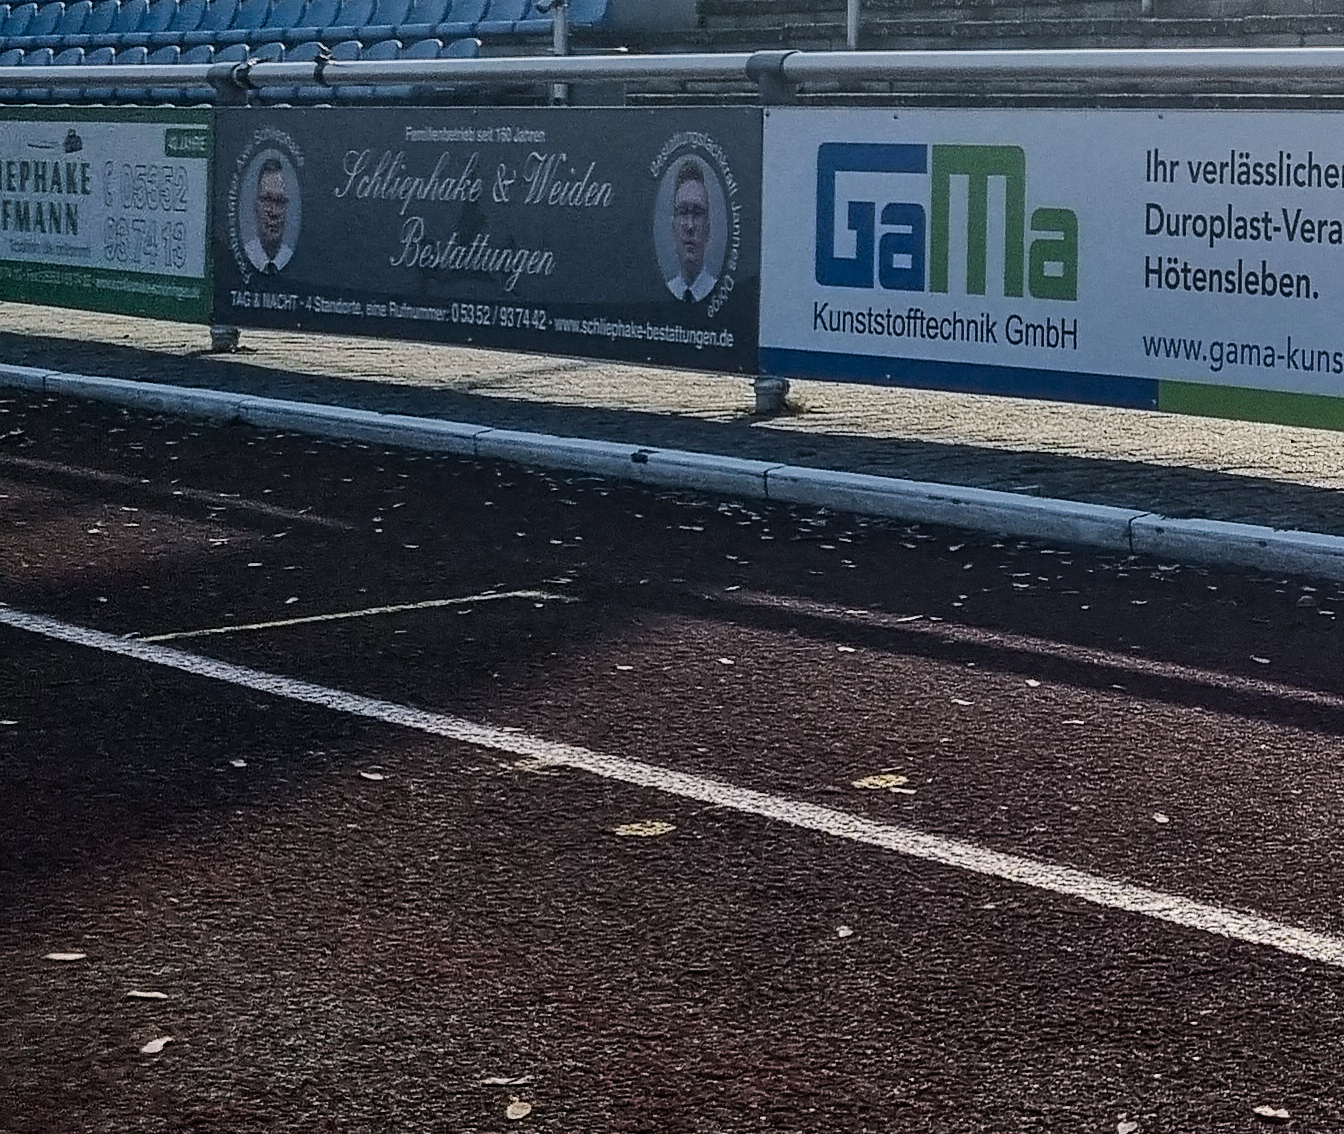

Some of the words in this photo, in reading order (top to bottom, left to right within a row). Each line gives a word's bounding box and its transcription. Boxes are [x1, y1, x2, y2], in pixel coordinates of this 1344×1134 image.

[335, 149, 483, 216] Schliephake
[493, 163, 517, 202] &
[523, 151, 614, 207] Weiden
[1146, 148, 1180, 183] Ihr
[389, 216, 556, 293] Bestattungen
[1144, 255, 1319, 300] Hötensleben.
[230, 290, 251, 308] TAG
[262, 293, 299, 311] NACHT
[366, 301, 387, 317] eine
[554, 318, 734, 349] www.schliephake-bestattungen.de
[813, 301, 998, 344] Kunststofftechnik
[1004, 313, 1078, 351] GmbH
